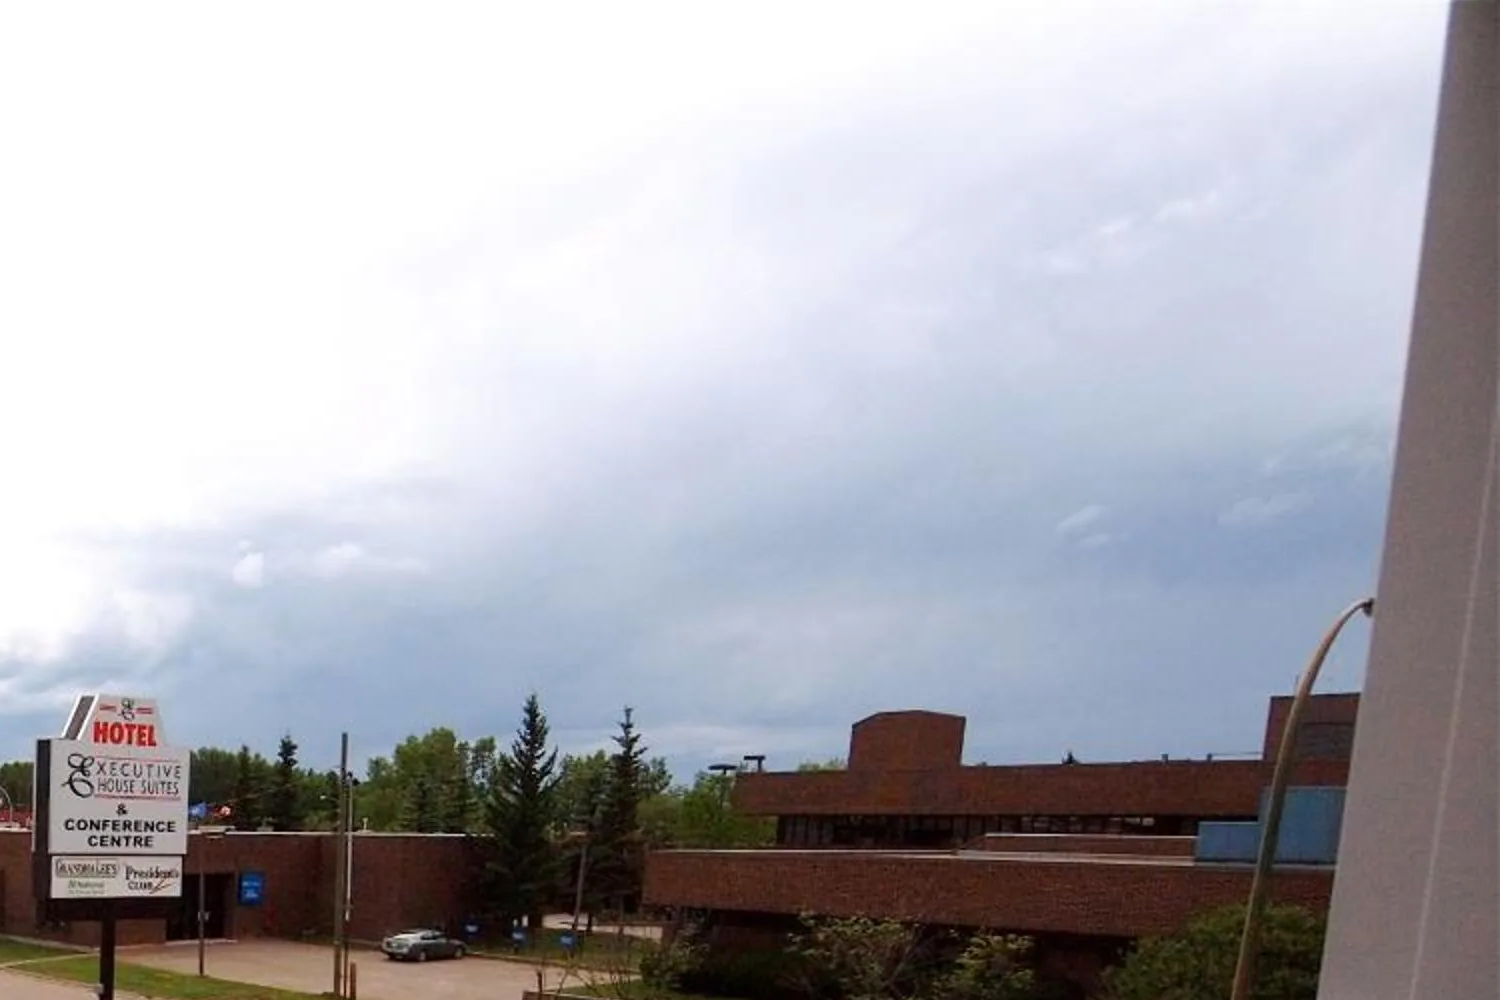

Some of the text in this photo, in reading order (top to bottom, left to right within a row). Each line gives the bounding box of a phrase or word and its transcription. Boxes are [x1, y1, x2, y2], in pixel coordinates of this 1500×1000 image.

[93, 721, 157, 747] HOTEL
[98, 778, 179, 796] HOUSE SUITES
[116, 803, 128, 816] &
[64, 819, 177, 833] CONFERENCE
[87, 835, 156, 848] CENTRE
